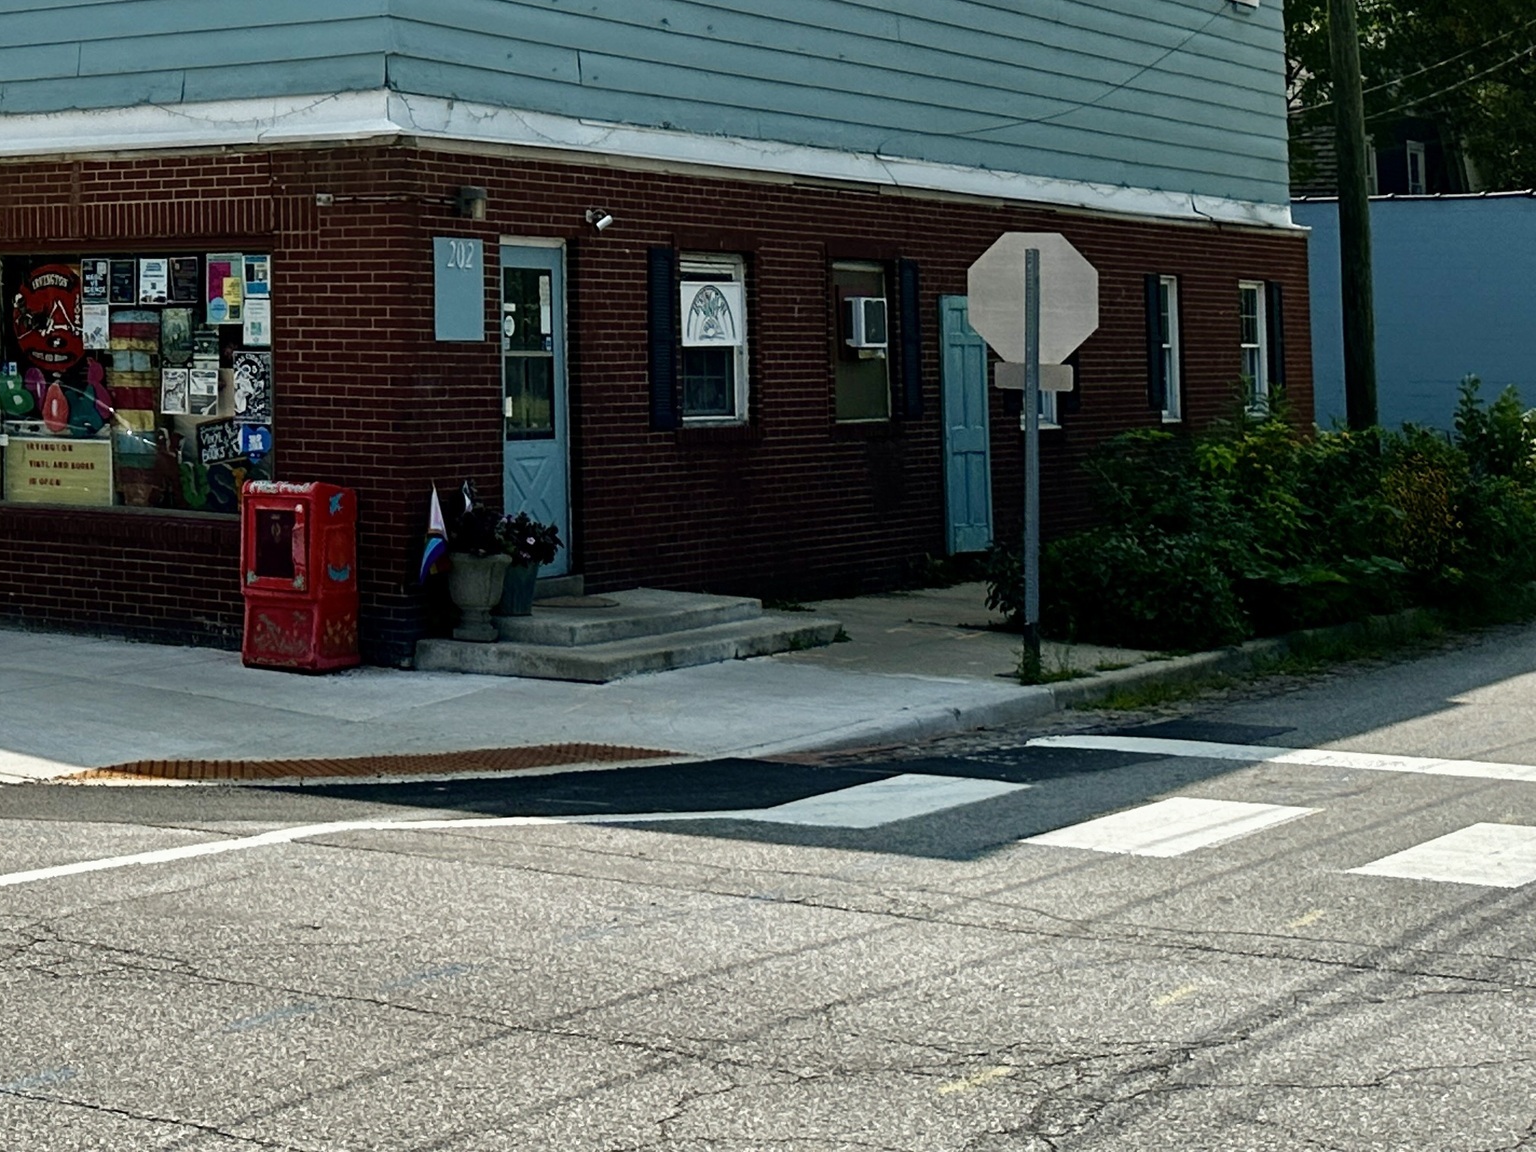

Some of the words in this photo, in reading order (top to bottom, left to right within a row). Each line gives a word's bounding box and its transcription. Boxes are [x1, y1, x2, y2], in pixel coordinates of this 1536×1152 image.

[447, 240, 474, 269] 202
[26, 443, 73, 452] IRVINGTON
[29, 460, 50, 468] VINYL
[53, 461, 69, 469] AND
